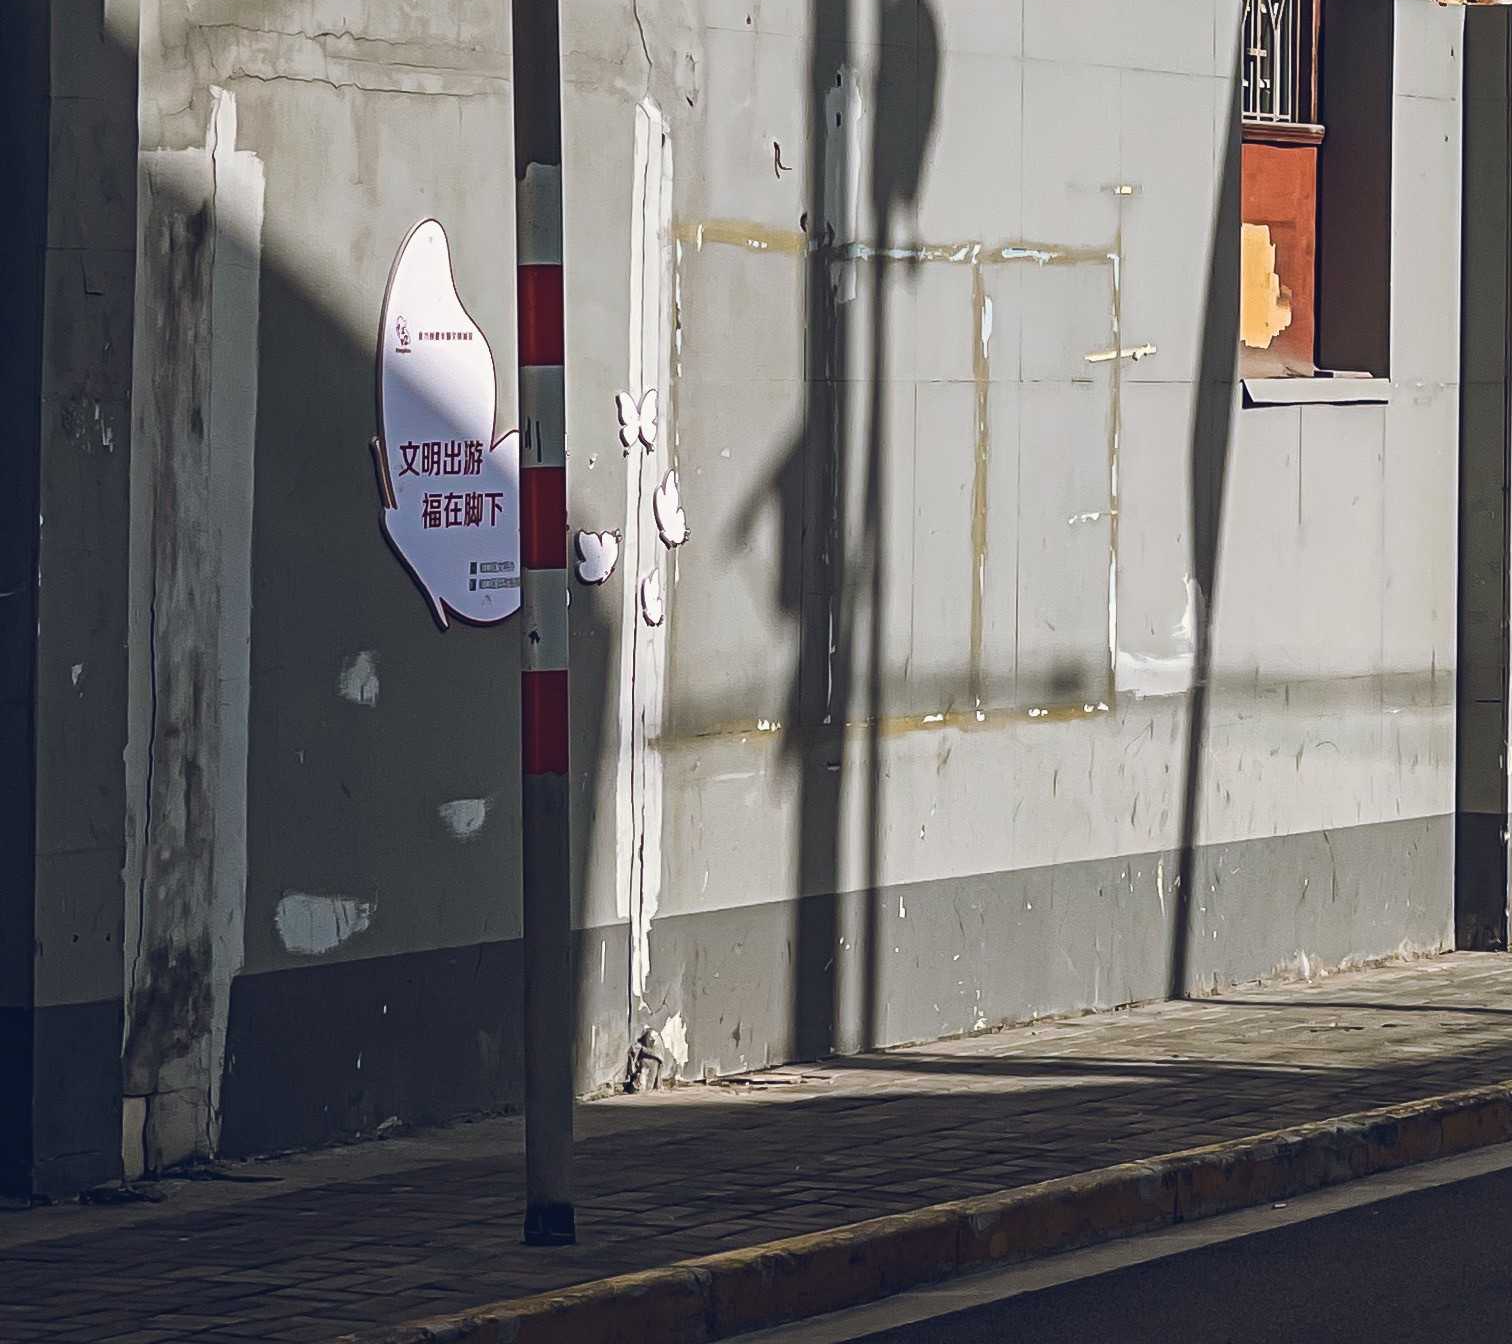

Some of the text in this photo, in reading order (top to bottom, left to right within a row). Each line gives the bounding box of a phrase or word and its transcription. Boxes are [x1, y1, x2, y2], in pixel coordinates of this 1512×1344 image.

[398, 440, 484, 478] 文明出游
[422, 492, 504, 530] 福在脚下
